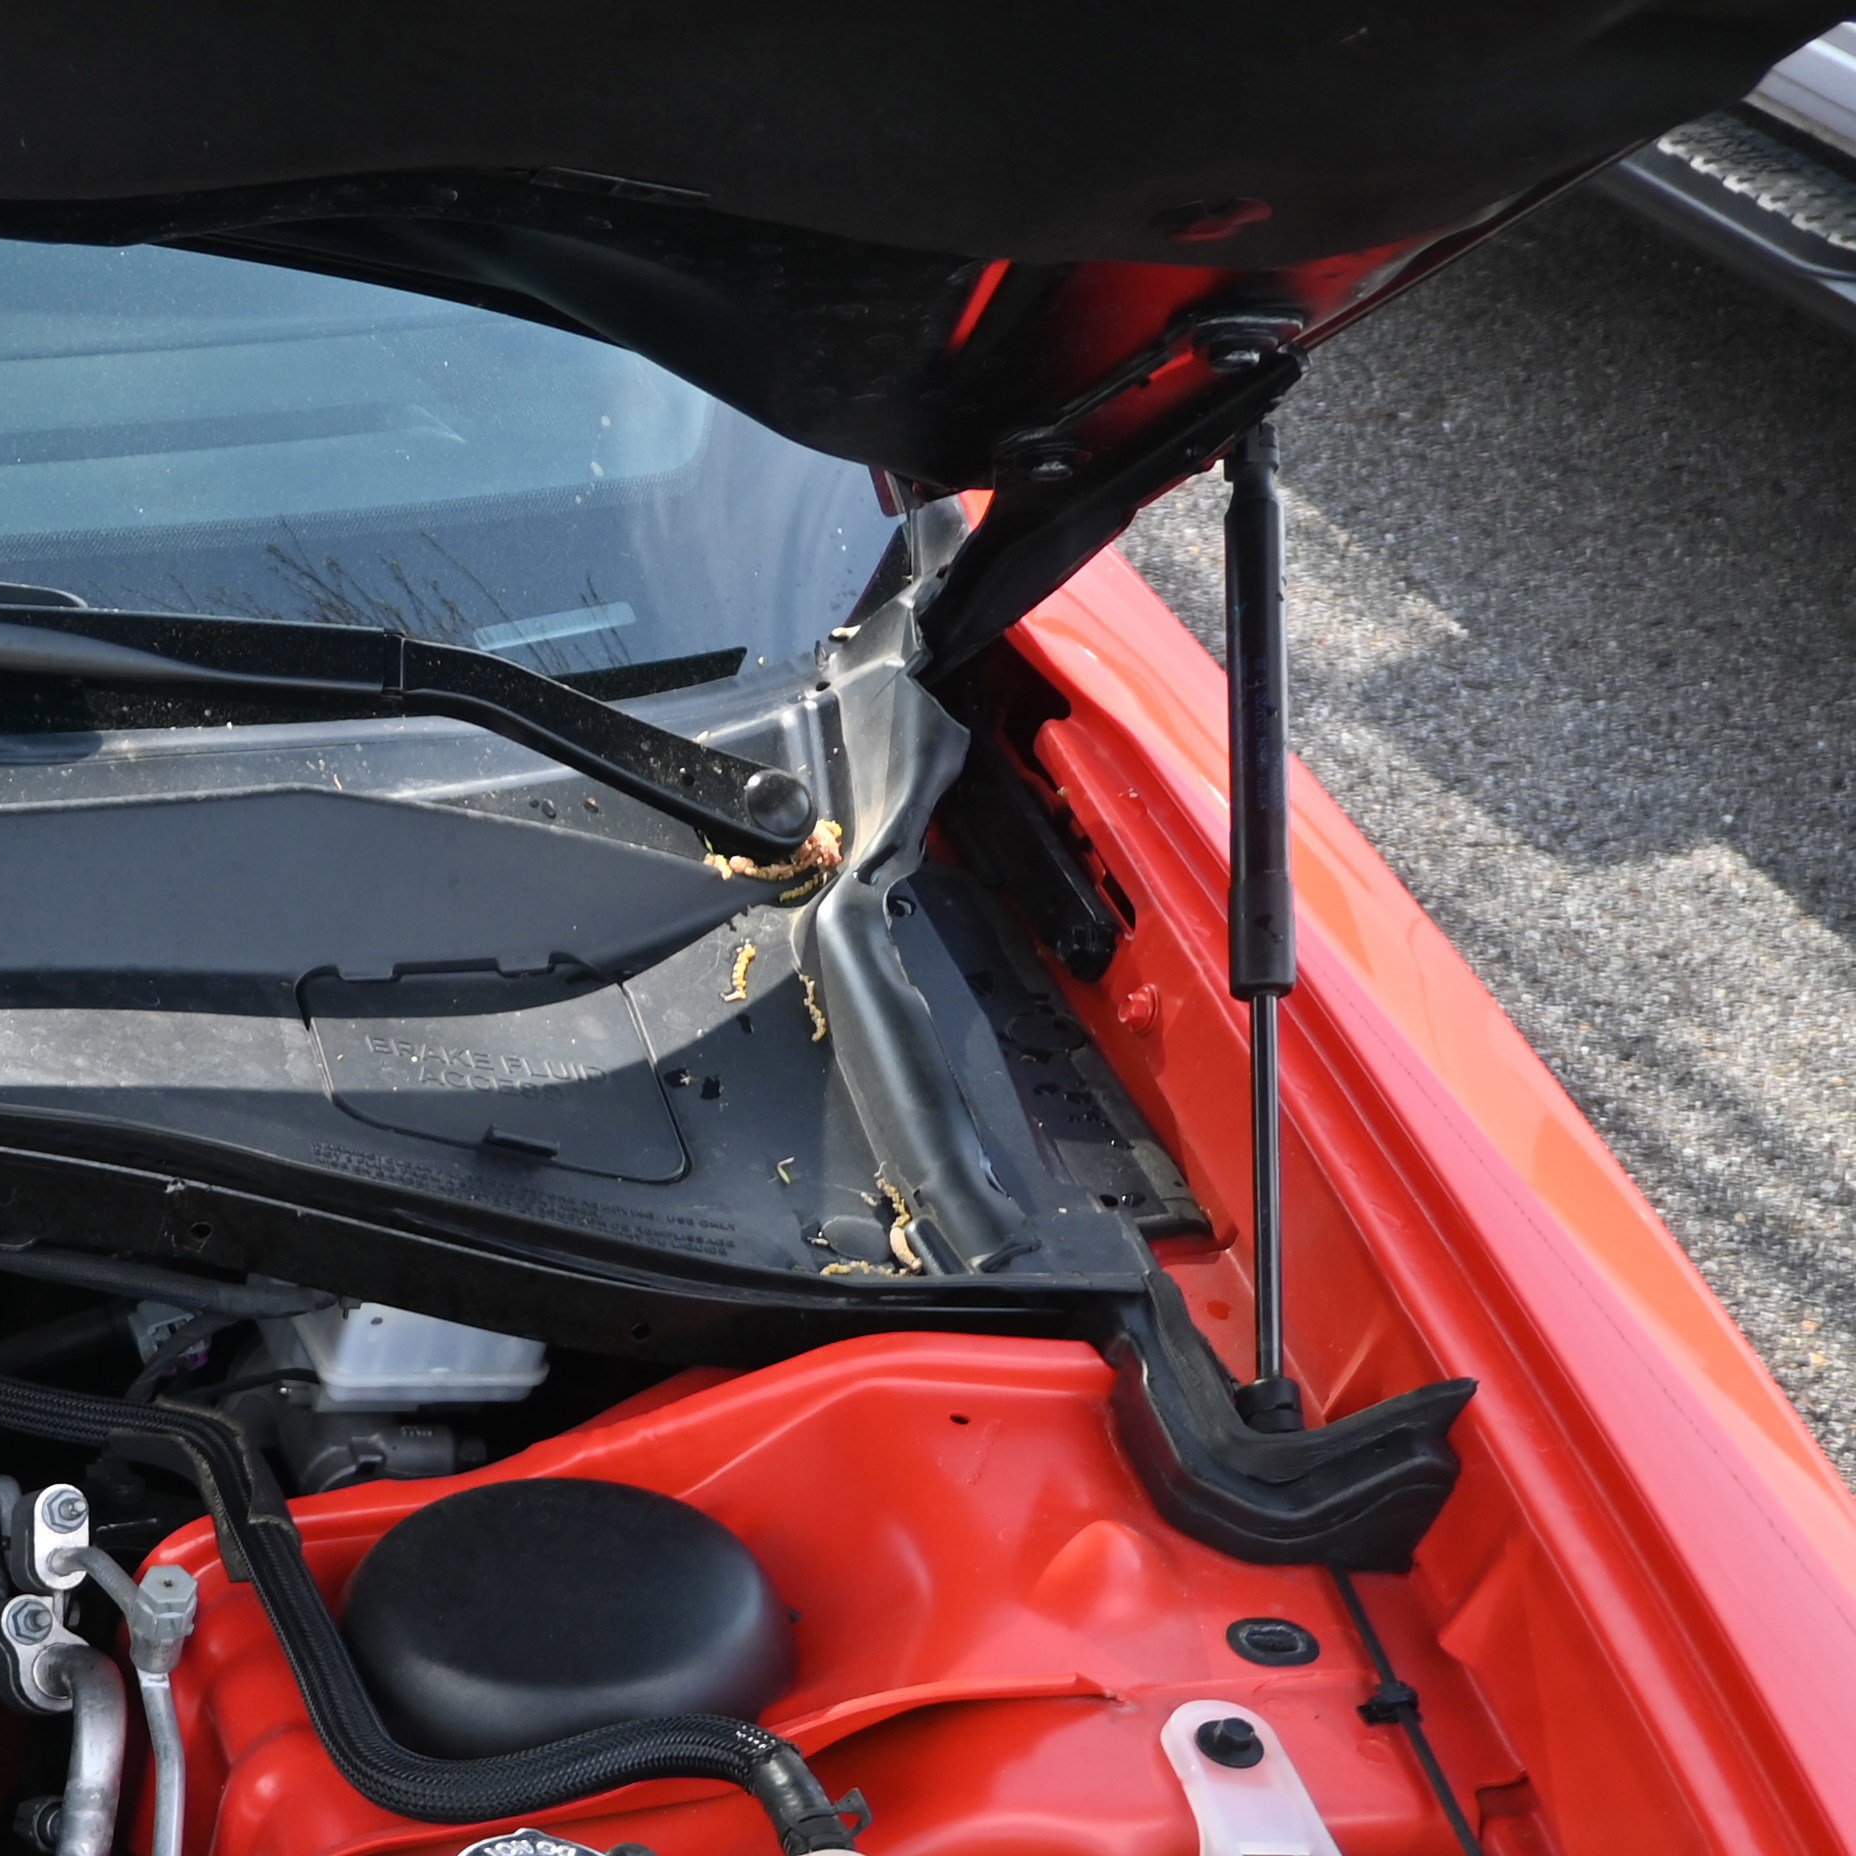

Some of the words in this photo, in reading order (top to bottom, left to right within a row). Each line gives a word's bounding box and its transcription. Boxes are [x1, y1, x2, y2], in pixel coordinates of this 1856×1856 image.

[365, 1033, 494, 1070] BRAKE
[498, 1054, 608, 1085] FLUID
[418, 1065, 565, 1101] ACCESS
